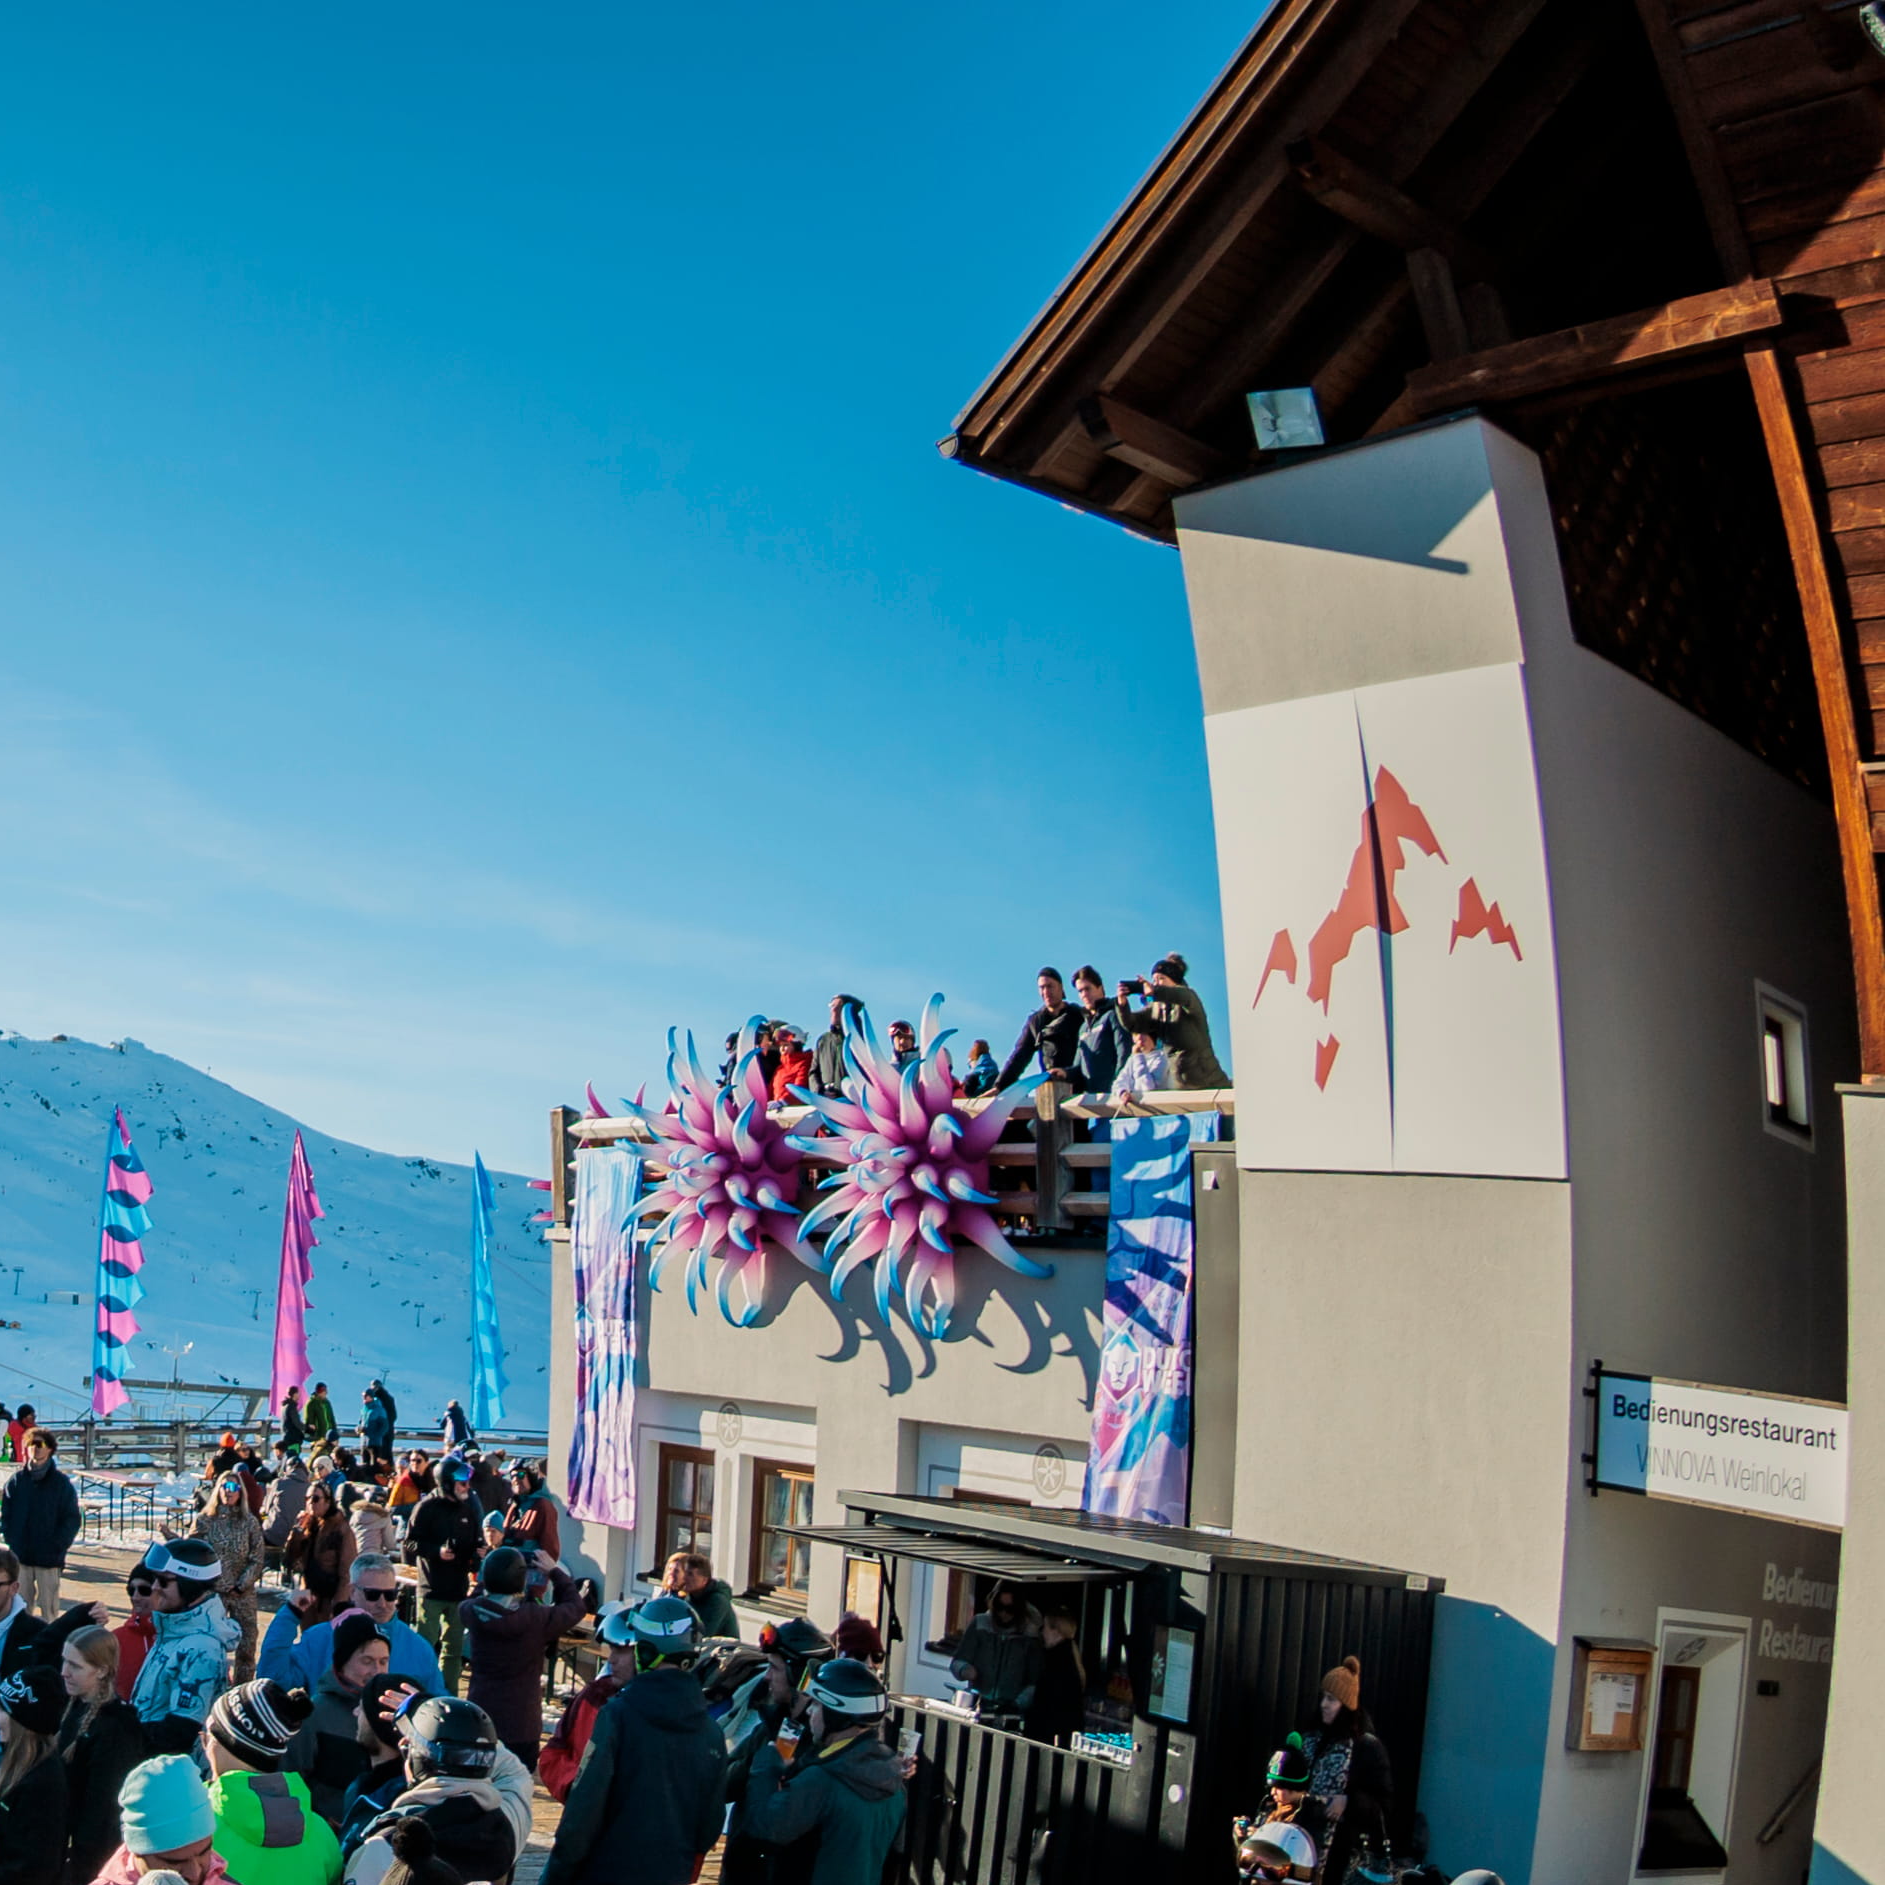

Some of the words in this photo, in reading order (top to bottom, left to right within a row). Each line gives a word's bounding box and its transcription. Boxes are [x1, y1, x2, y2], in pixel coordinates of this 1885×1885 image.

[1142, 1346, 1191, 1372] DUTC
[1613, 1394, 1837, 1450] Bedienungsrestaurant
[1636, 1443, 1718, 1486] VINNOVA
[1722, 1456, 1807, 1501] Weinlokal
